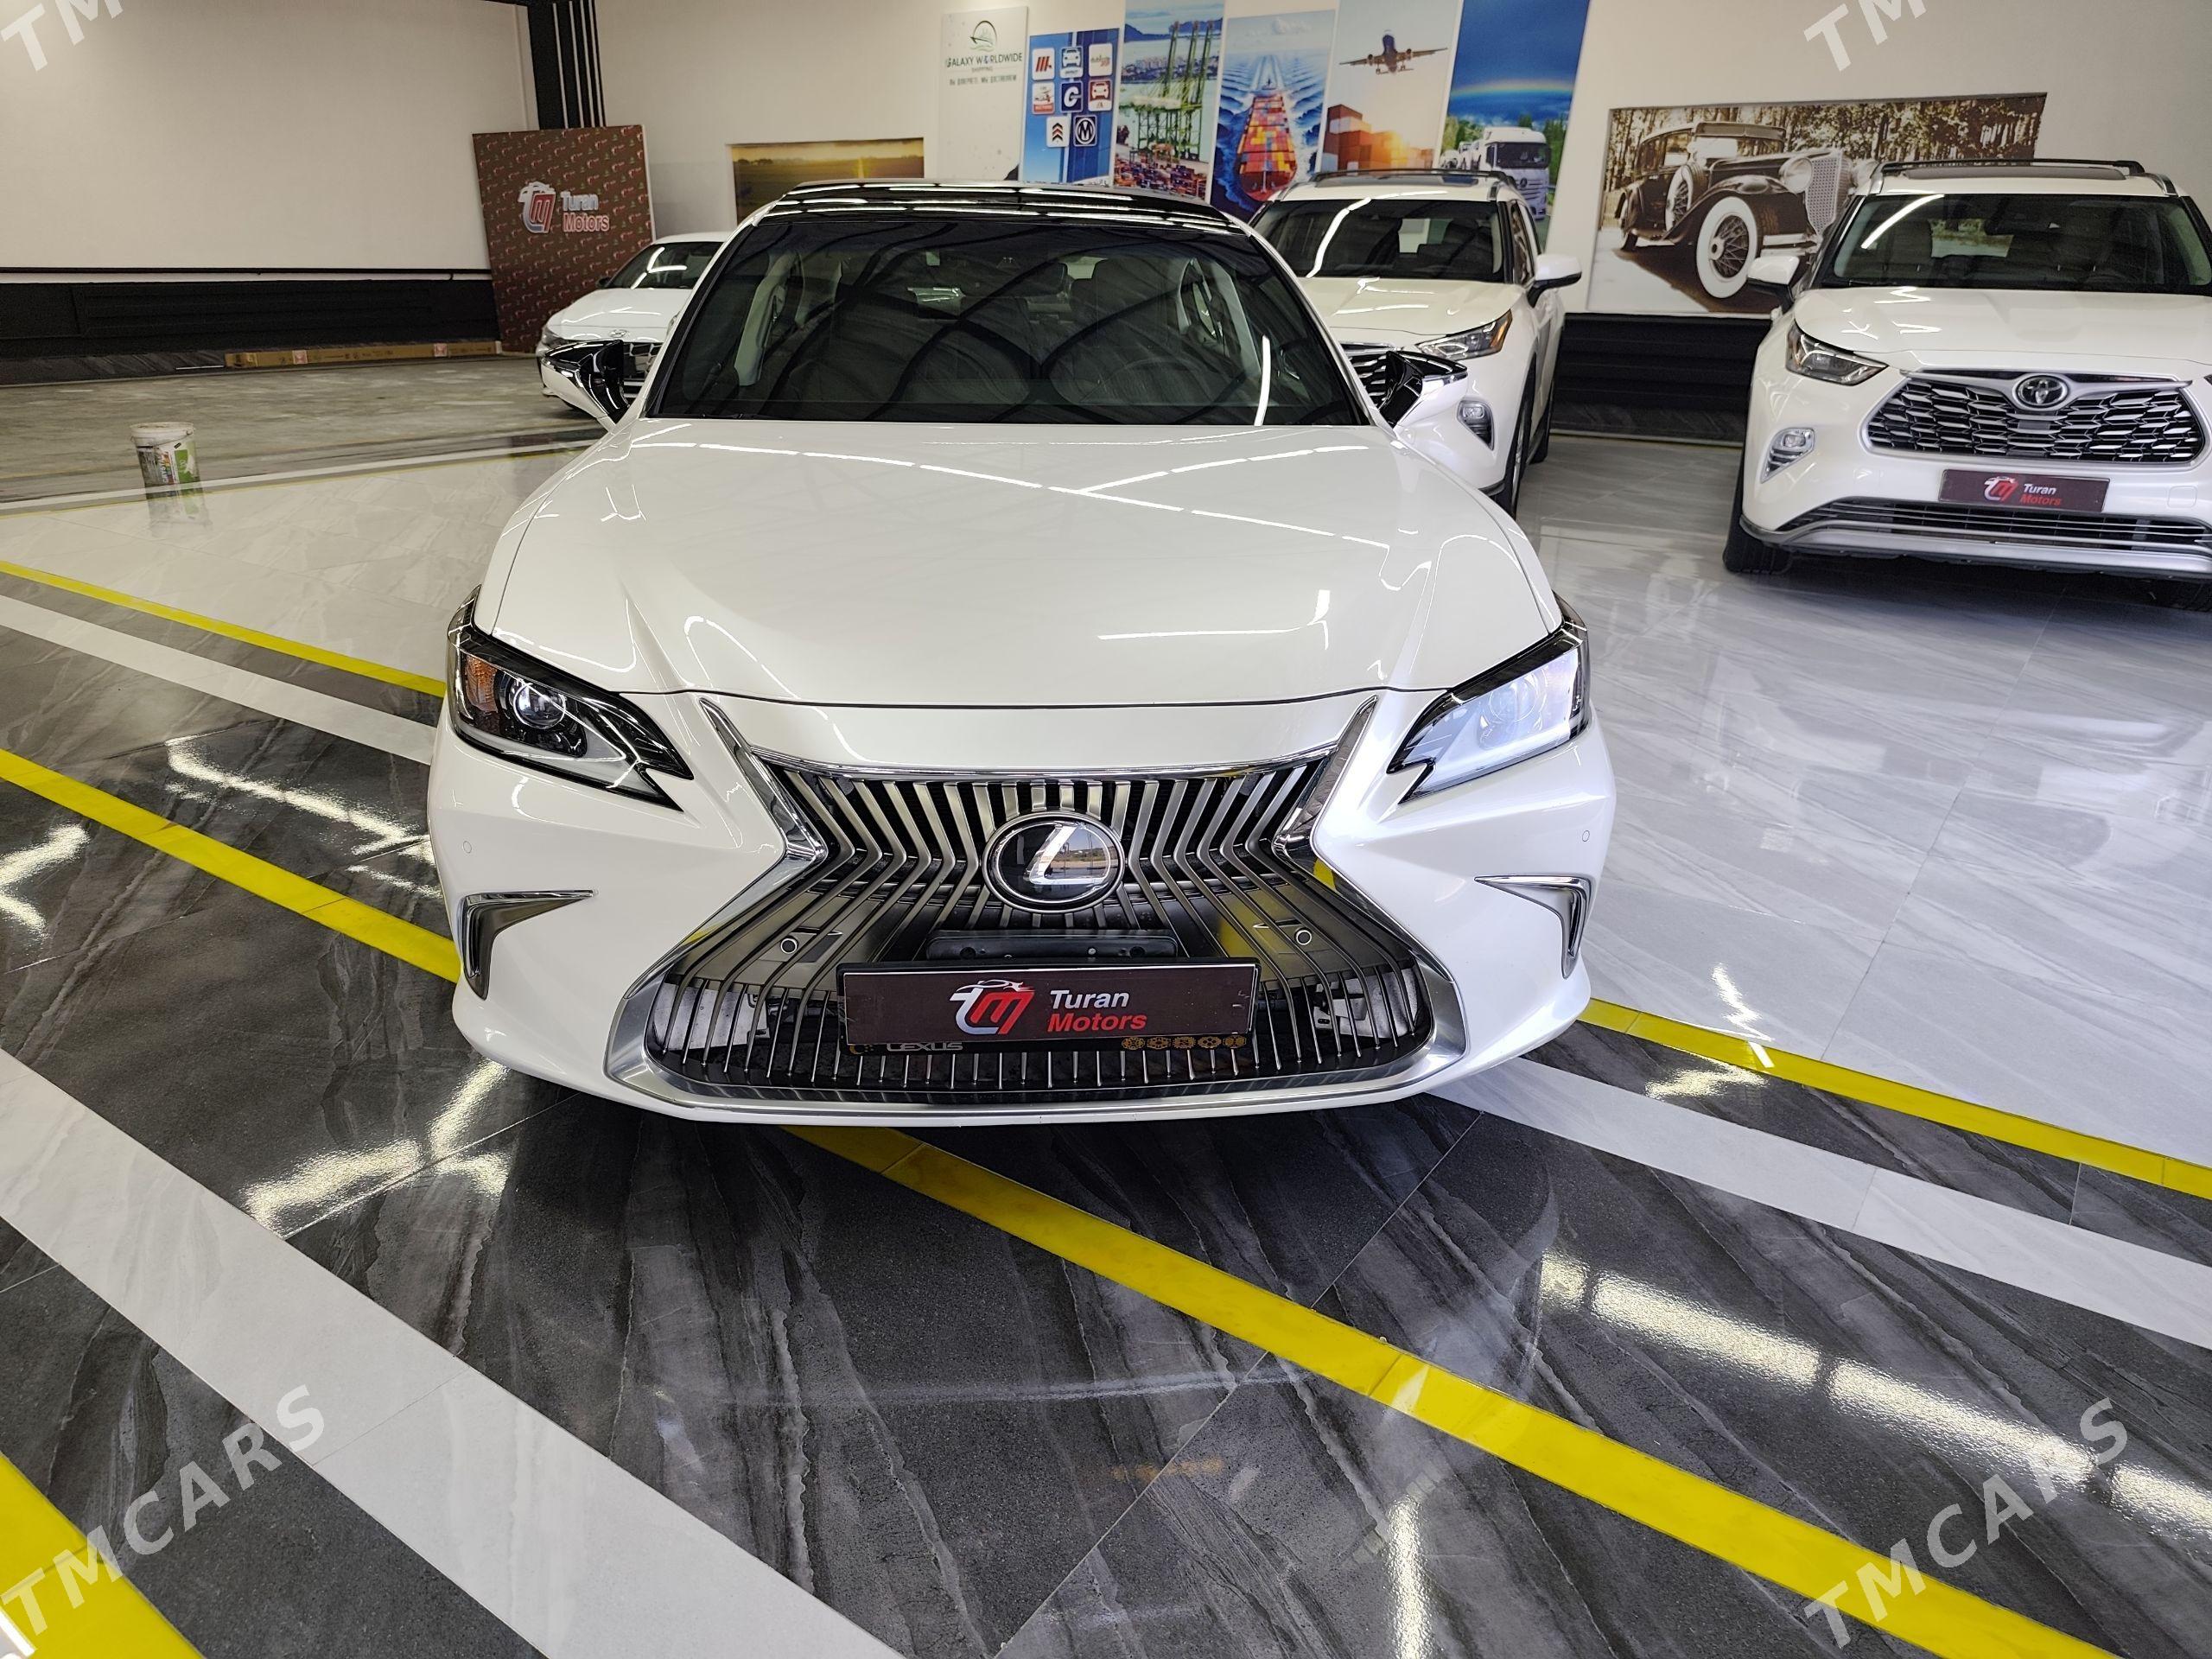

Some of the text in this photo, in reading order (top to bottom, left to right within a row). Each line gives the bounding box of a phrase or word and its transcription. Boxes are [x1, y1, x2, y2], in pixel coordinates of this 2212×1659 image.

[946, 56, 974, 67] GALAXY
[560, 190, 599, 212] Turan
[563, 213, 609, 232] Motors
[2024, 484, 2056, 494] Turan
[2021, 495, 2061, 505] Motors
[1049, 989, 1130, 1010] Turan
[1047, 1012, 1148, 1033] Motors
[886, 1042, 963, 1052] LEXUS
